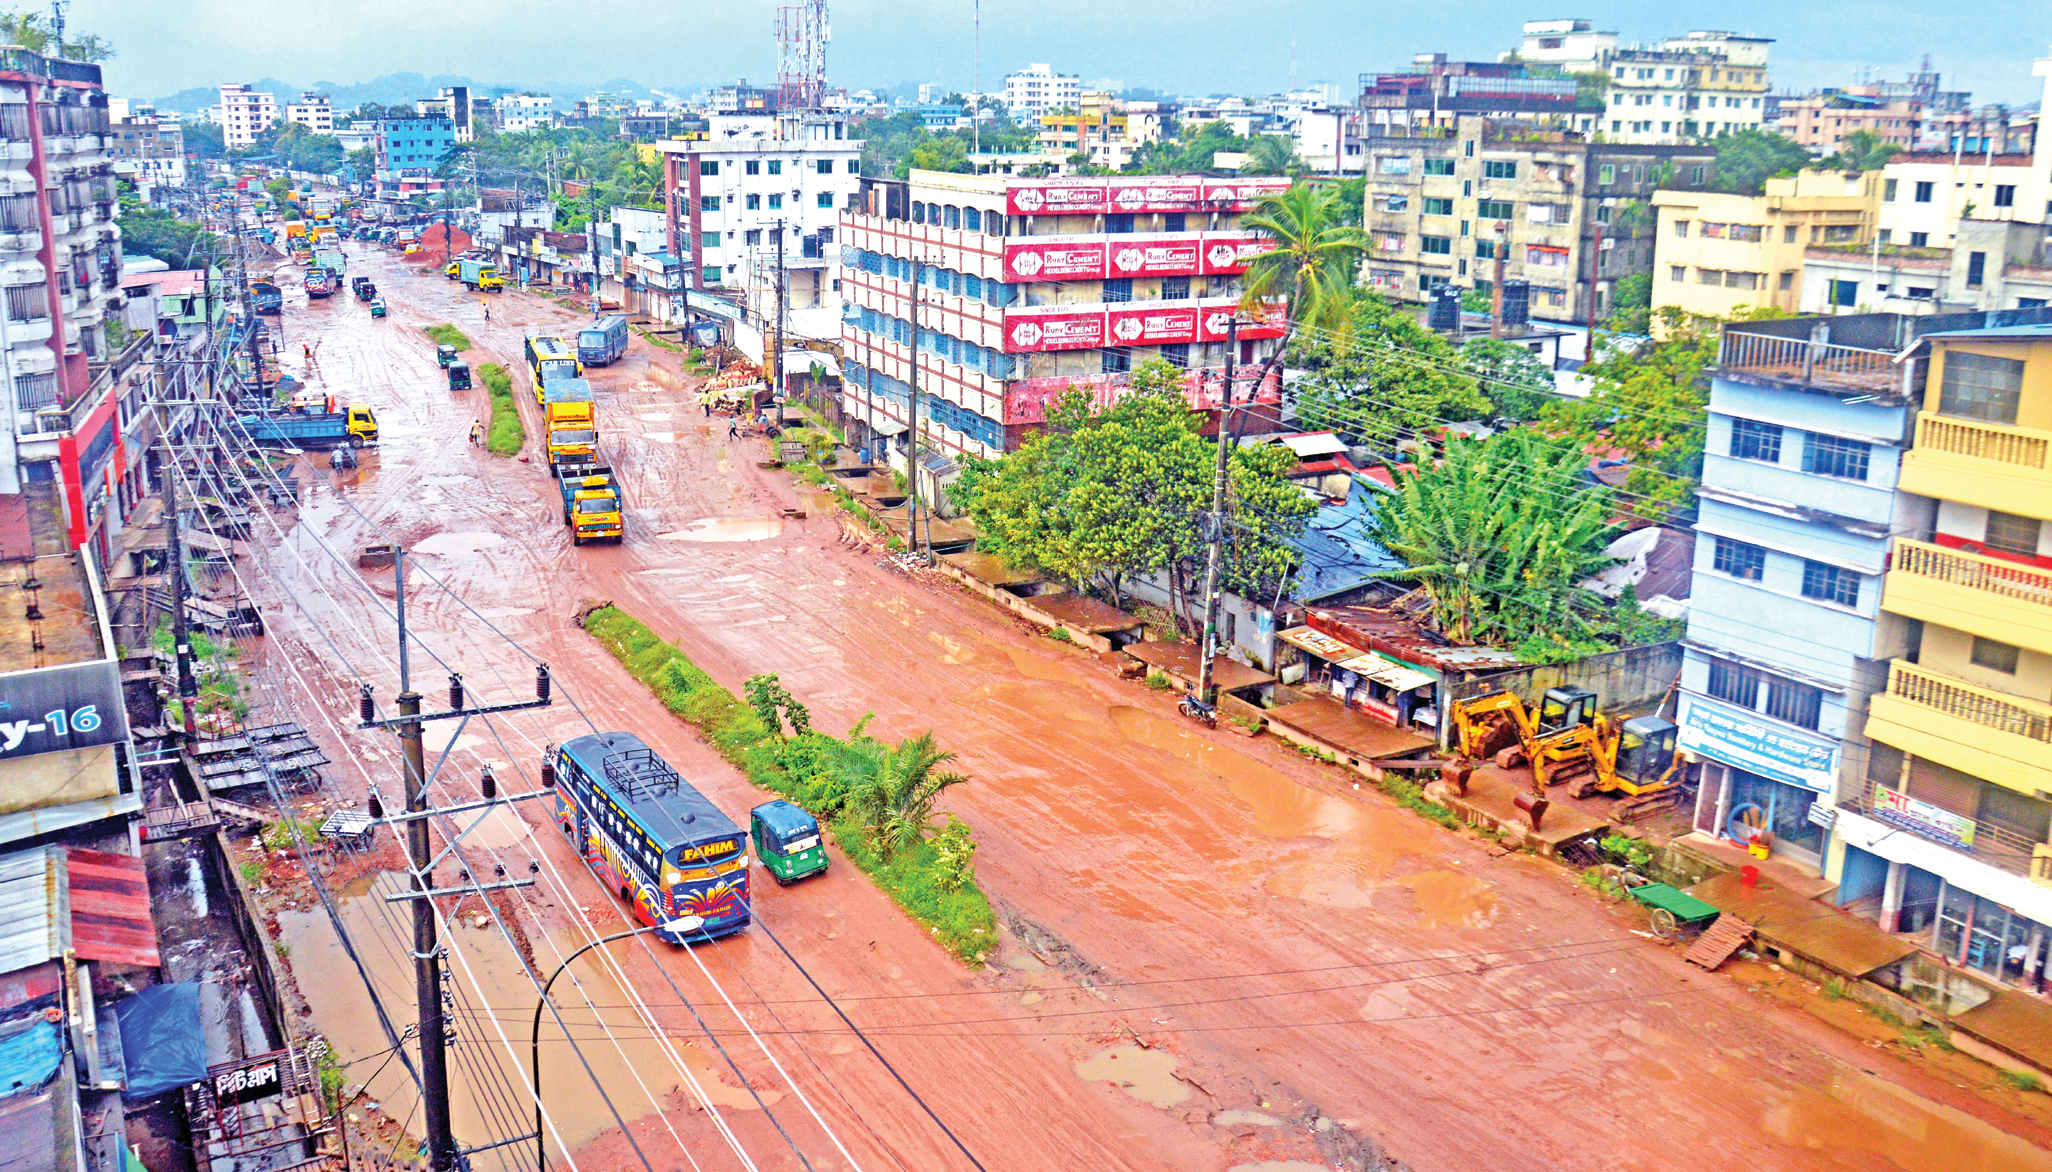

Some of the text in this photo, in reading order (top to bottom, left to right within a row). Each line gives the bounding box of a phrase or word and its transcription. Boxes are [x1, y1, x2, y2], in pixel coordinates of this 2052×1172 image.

[1068, 191, 1099, 200] CEMENT
[1166, 190, 1193, 199] CEMENT
[1067, 253, 1098, 263] CEMENT
[1167, 250, 1194, 260] CEMENT
[1065, 324, 1098, 333] CEMENT
[1165, 319, 1191, 329] CEMENT
[1757, 743, 1764, 752] &
[1885, 790, 1911, 813] মা
[685, 840, 734, 859] FAHIM
